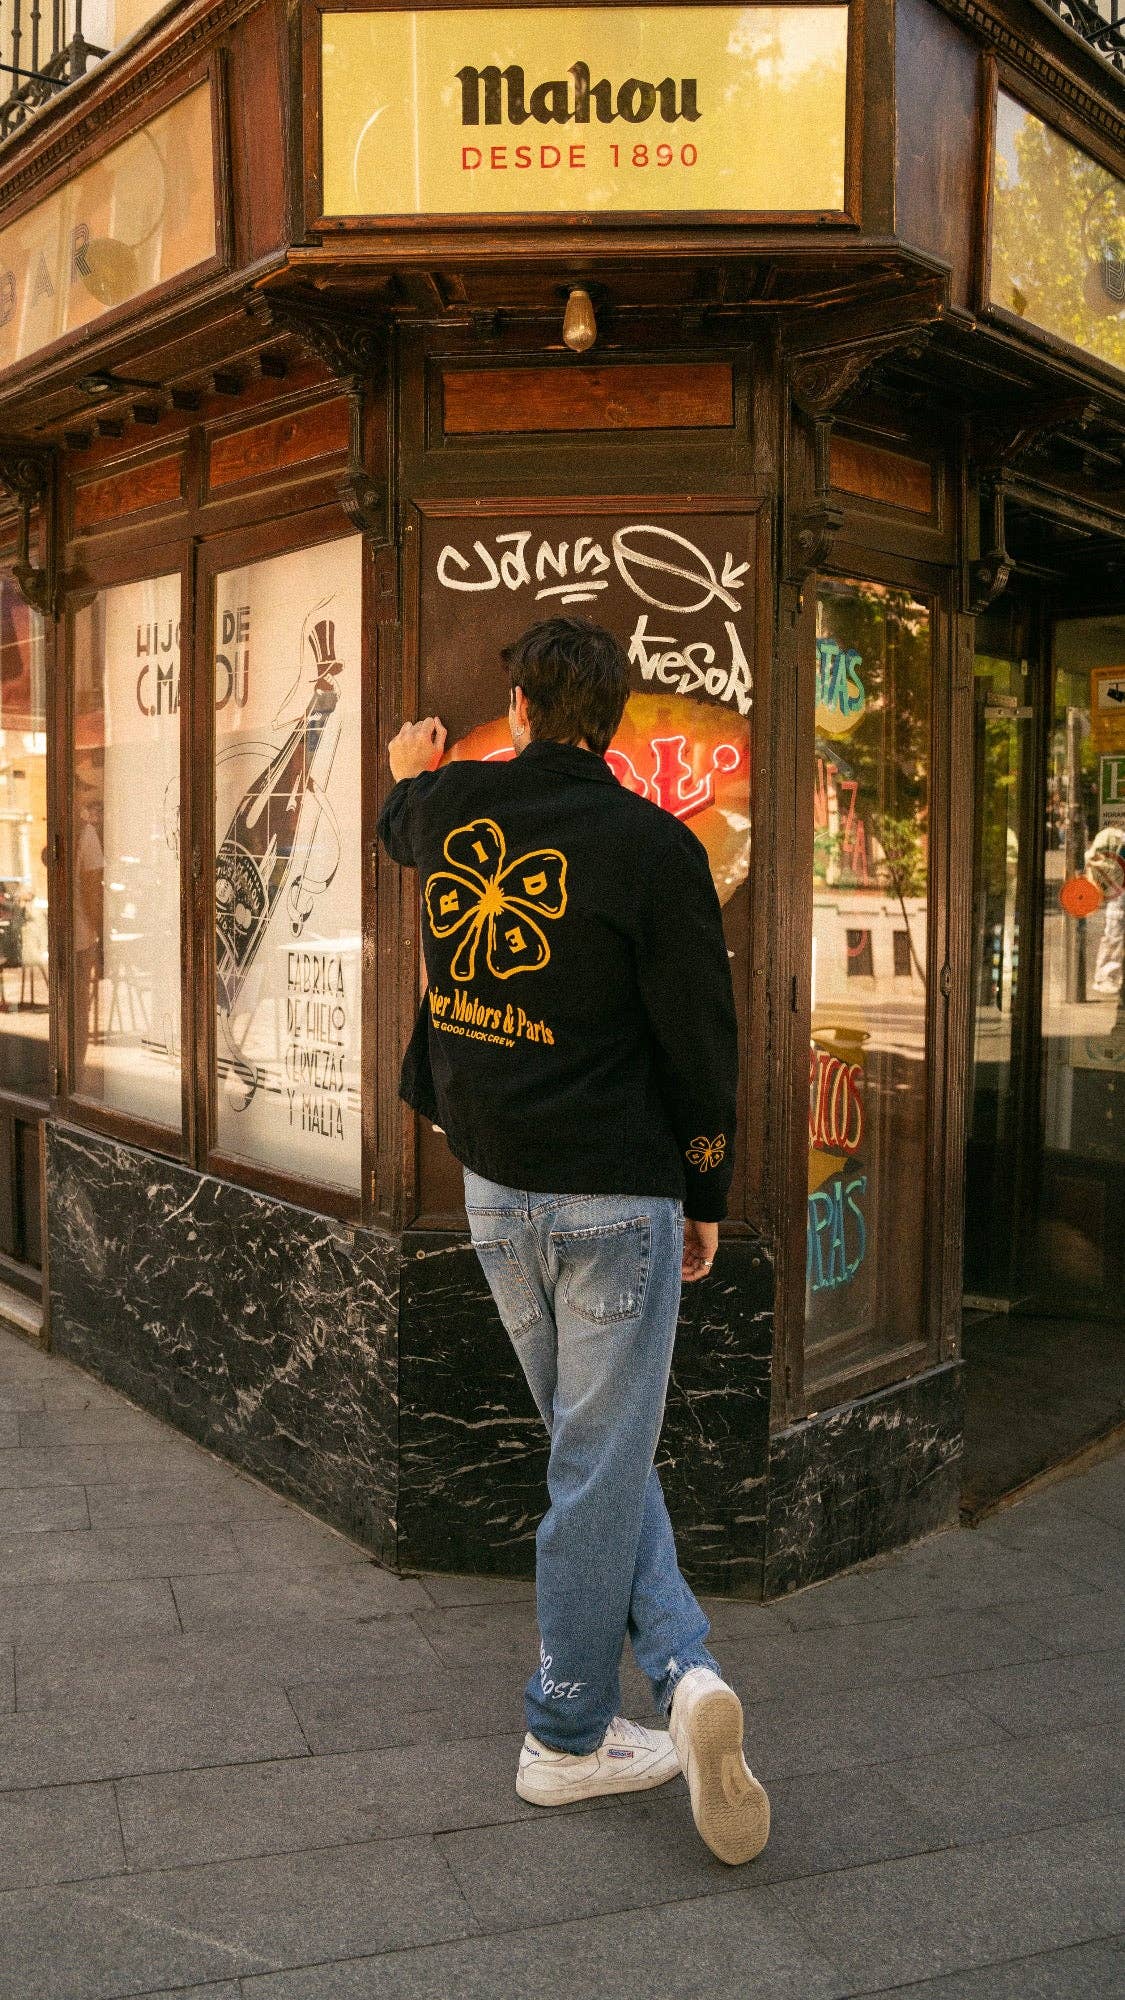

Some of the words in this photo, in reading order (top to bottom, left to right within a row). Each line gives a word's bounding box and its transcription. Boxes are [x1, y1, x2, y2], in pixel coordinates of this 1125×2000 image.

[462, 144, 586, 170] DESDE
[610, 143, 698, 168] 1890
[222, 605, 250, 645] DE
[440, 1022, 465, 1036] GOOD
[450, 988, 502, 1030] Motors
[503, 1003, 515, 1034] &
[516, 1007, 555, 1045] Parts
[302, 1092, 344, 1141] MALTA
